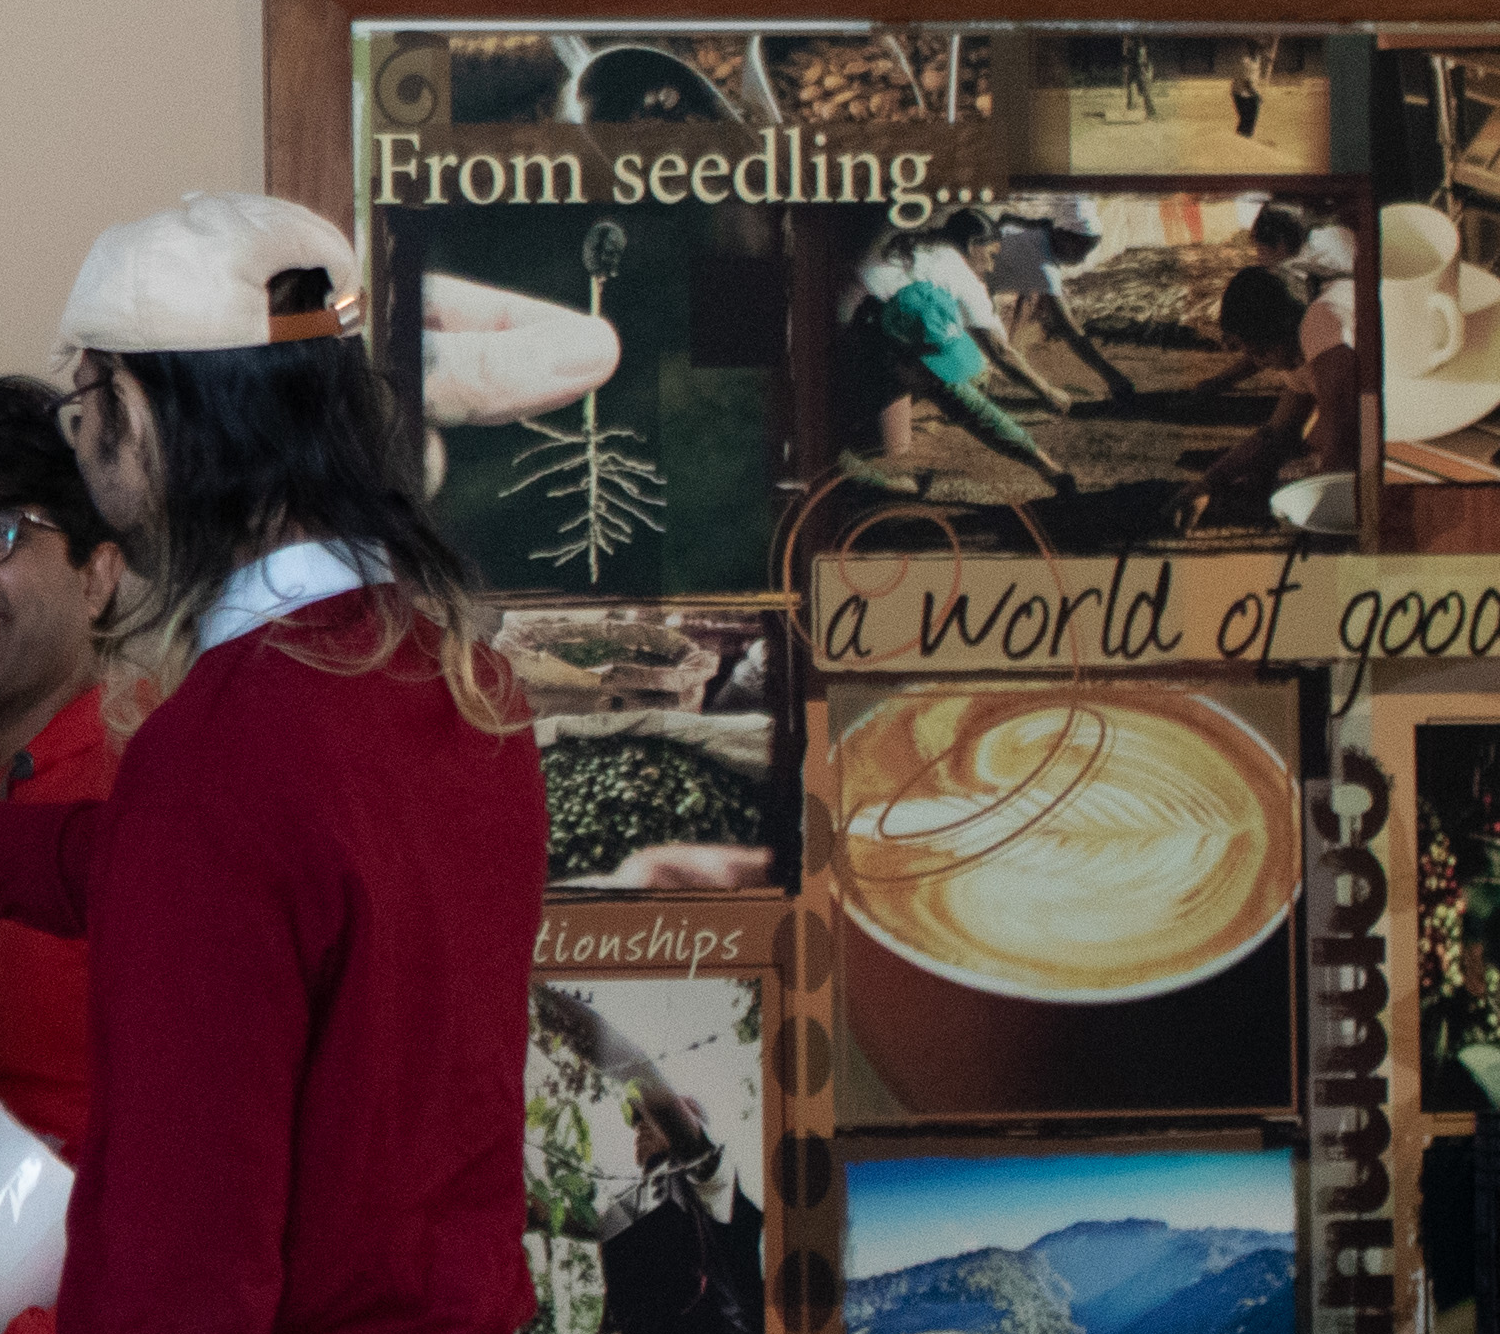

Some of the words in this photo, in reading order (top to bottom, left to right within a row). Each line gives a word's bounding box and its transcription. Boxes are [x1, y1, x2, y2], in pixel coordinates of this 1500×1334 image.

[372, 131, 589, 206] From
[611, 126, 996, 229] seedling...
[824, 593, 872, 661] a
[920, 547, 1184, 660] world
[1216, 540, 1310, 679] of
